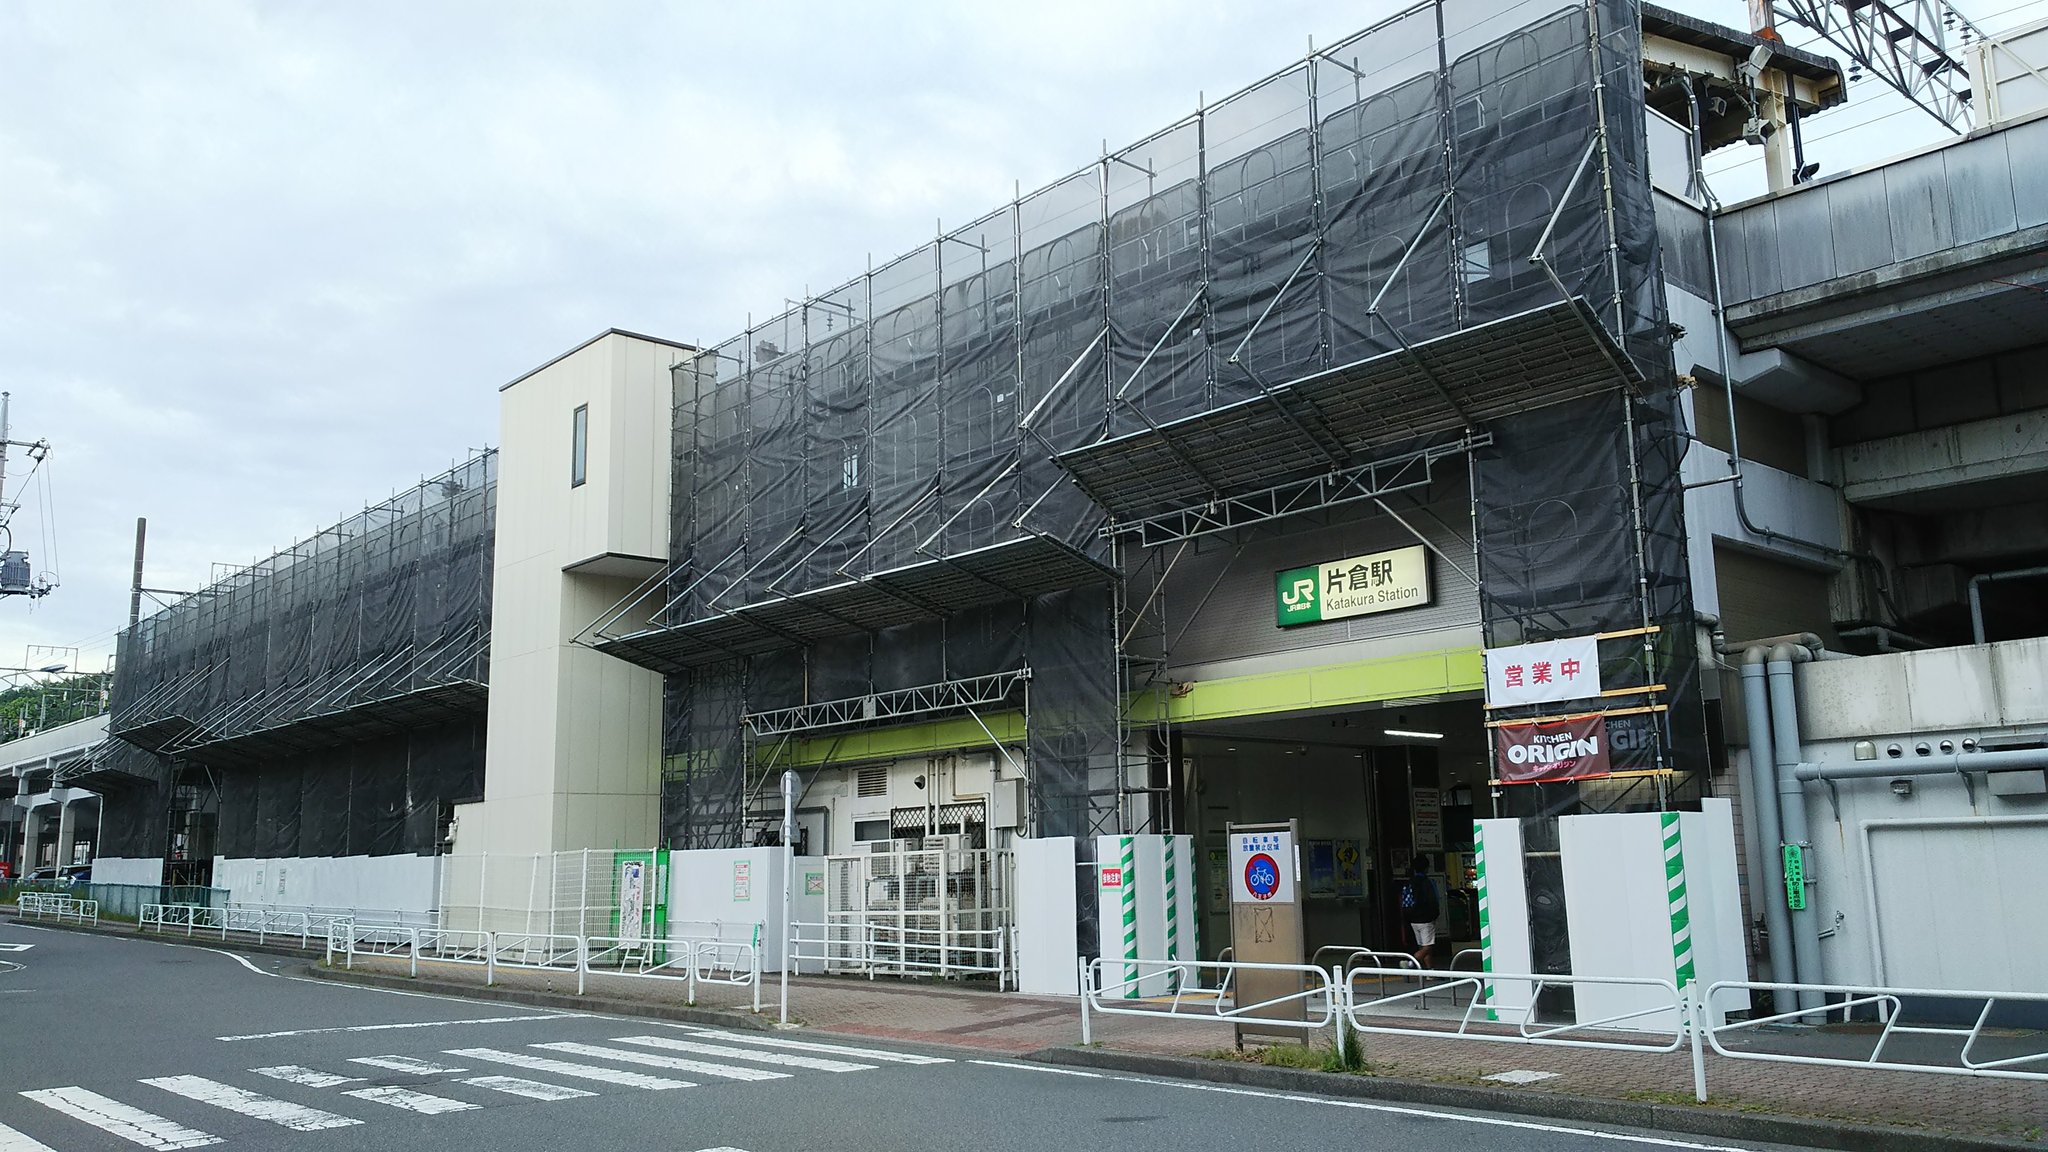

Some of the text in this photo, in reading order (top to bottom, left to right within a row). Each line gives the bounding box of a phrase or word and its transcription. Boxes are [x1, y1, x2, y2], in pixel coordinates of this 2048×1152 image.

[1326, 558, 1393, 595] 片倉駅
[1282, 578, 1315, 605] JR
[1326, 586, 1418, 611] Katakura Station
[1287, 602, 1312, 612] JR東日本
[1504, 657, 1580, 688] 営業中
[1507, 736, 1598, 764] ORIGIN
[1533, 731, 1573, 744] KITCHEN
[1532, 760, 1576, 773] キッチンオリジン
[1242, 835, 1279, 845] 自転車等
